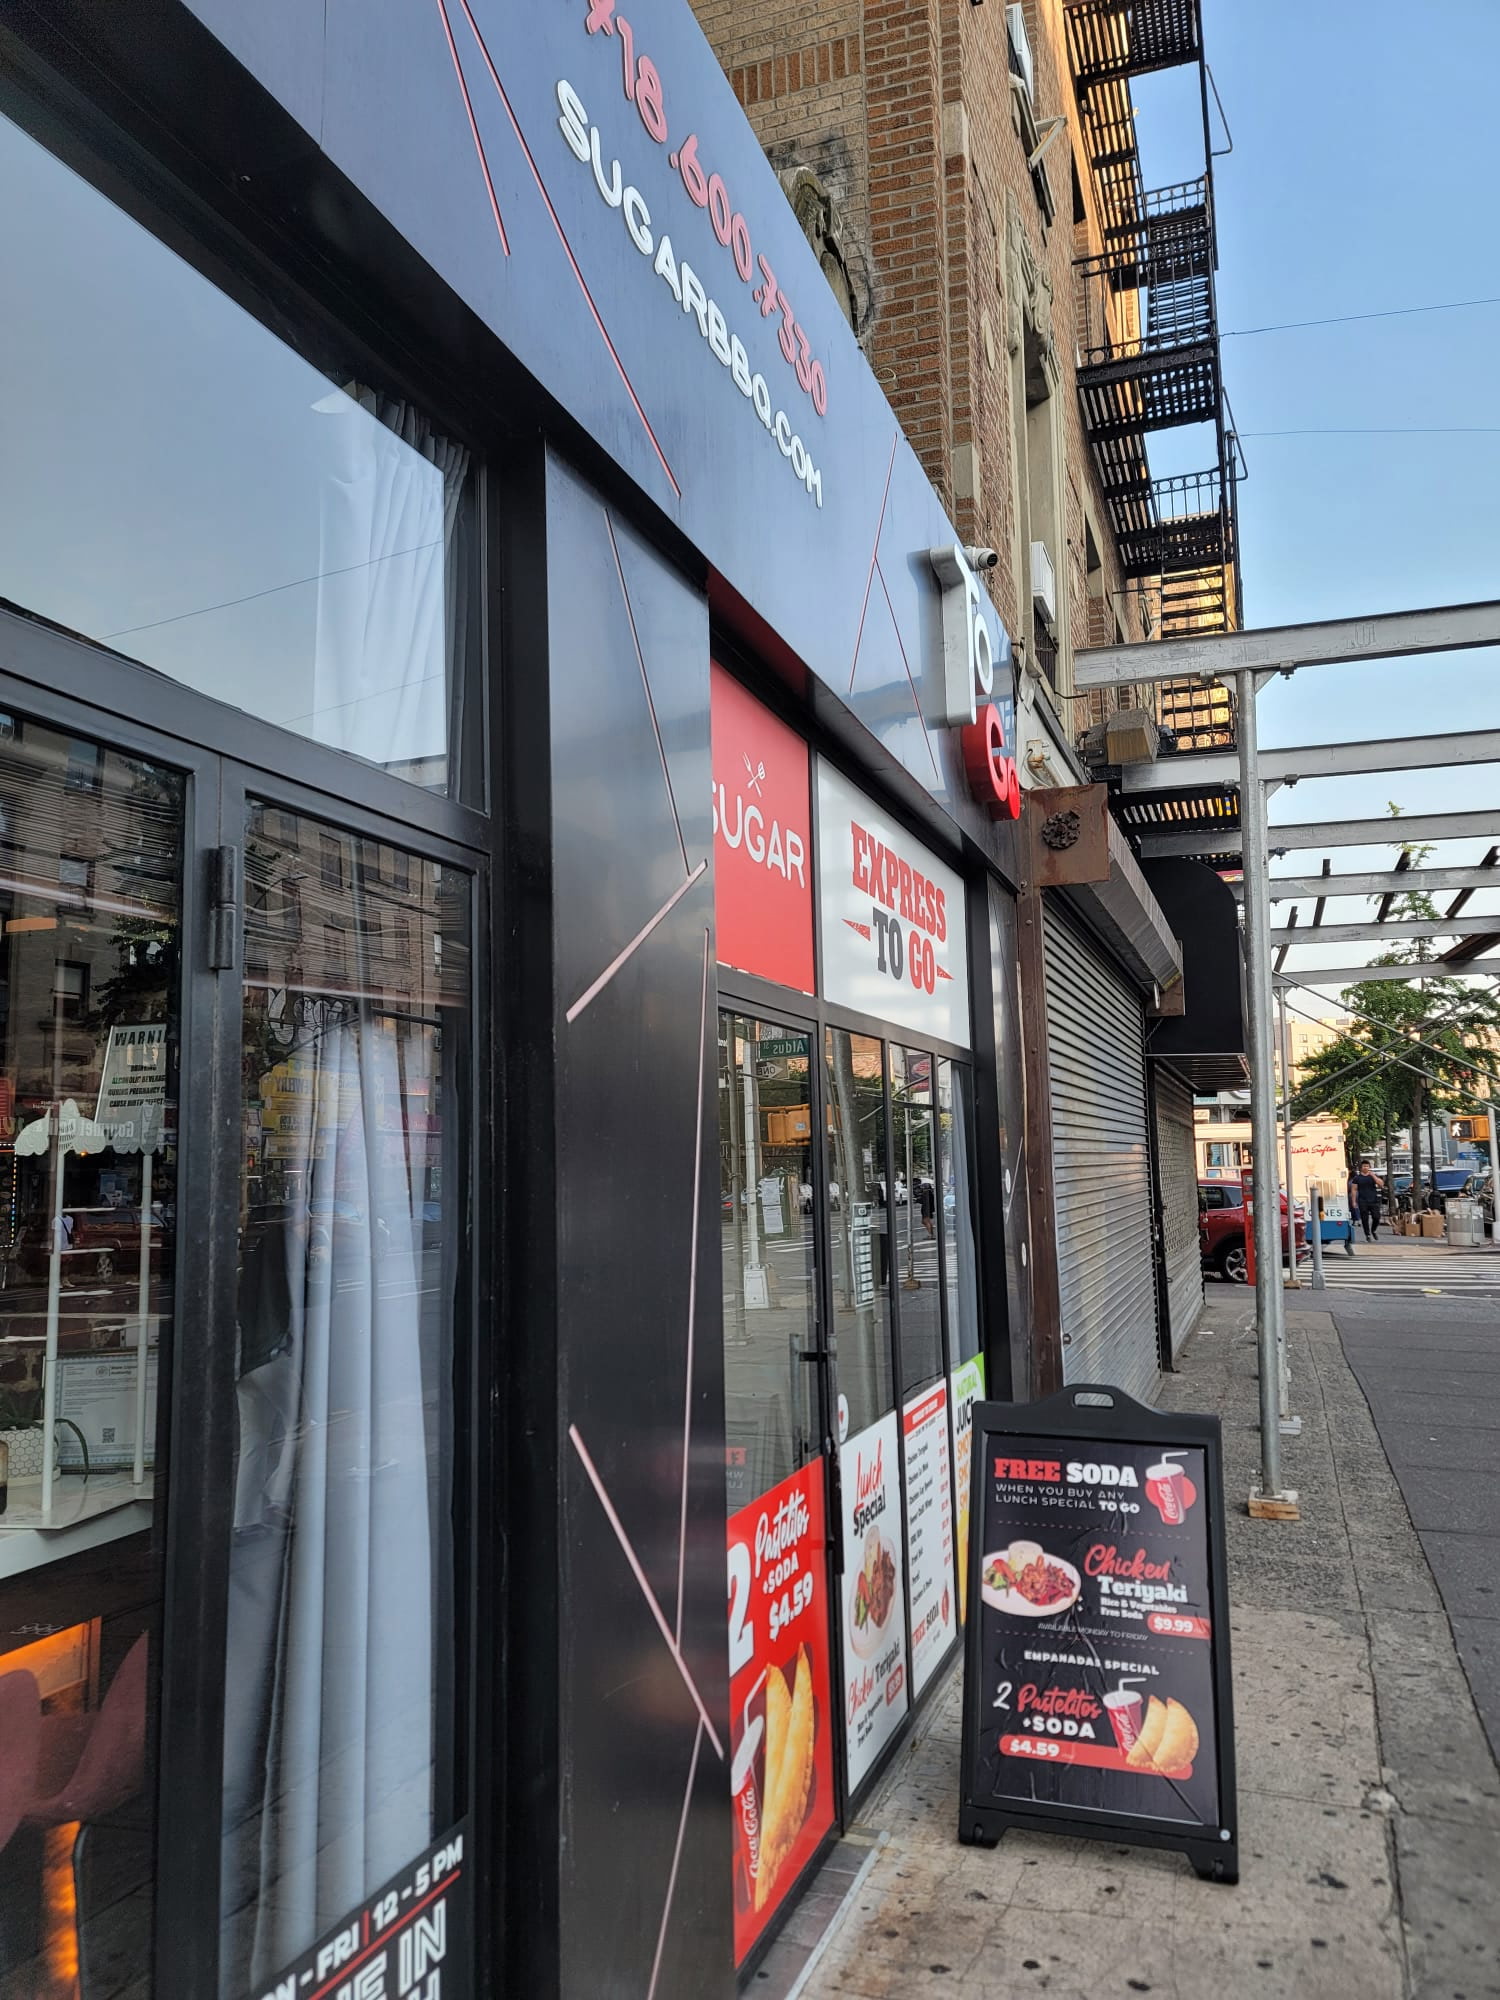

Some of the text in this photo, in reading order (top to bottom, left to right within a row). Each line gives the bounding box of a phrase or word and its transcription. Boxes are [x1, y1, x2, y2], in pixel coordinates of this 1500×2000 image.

[557, 79, 823, 508] SUGARBBQ.COM
[851, 820, 947, 943] EXPRESS
[872, 906, 935, 995] TO GO
[956, 1395, 974, 1435] JUIC
[993, 1457, 1062, 1482] FREE
[1066, 1462, 1139, 1487] SODA
[995, 1483, 1125, 1500] WHEN YOU BUY ANY
[995, 1494, 1140, 1514] LUNCH SPECIAL TO GO
[853, 1484, 886, 1539] Special
[755, 1488, 810, 1579] Pastelitos
[1084, 1543, 1171, 1581] Chicken
[769, 1571, 814, 1642] $4.59
[1097, 1575, 1188, 1603] Teriyaki
[1100, 1597, 1120, 1607] Rice
[1129, 1599, 1178, 1614] Vegetables
[727, 1542, 754, 1678] 2
[1121, 1609, 1144, 1620] Soda
[1153, 1616, 1193, 1633] $9.99
[1024, 1650, 1159, 1676] EMPANADAS SPECIAL
[992, 1681, 1103, 1719] 2 Pastelitos
[1010, 1738, 1060, 1757] $4.59
[317, 1921, 360, 1982] FRI
[372, 1890, 399, 1932] 12
[415, 1862, 429, 1897] 5
[433, 1834, 463, 1882] PM
[399, 1897, 447, 1998] IN
